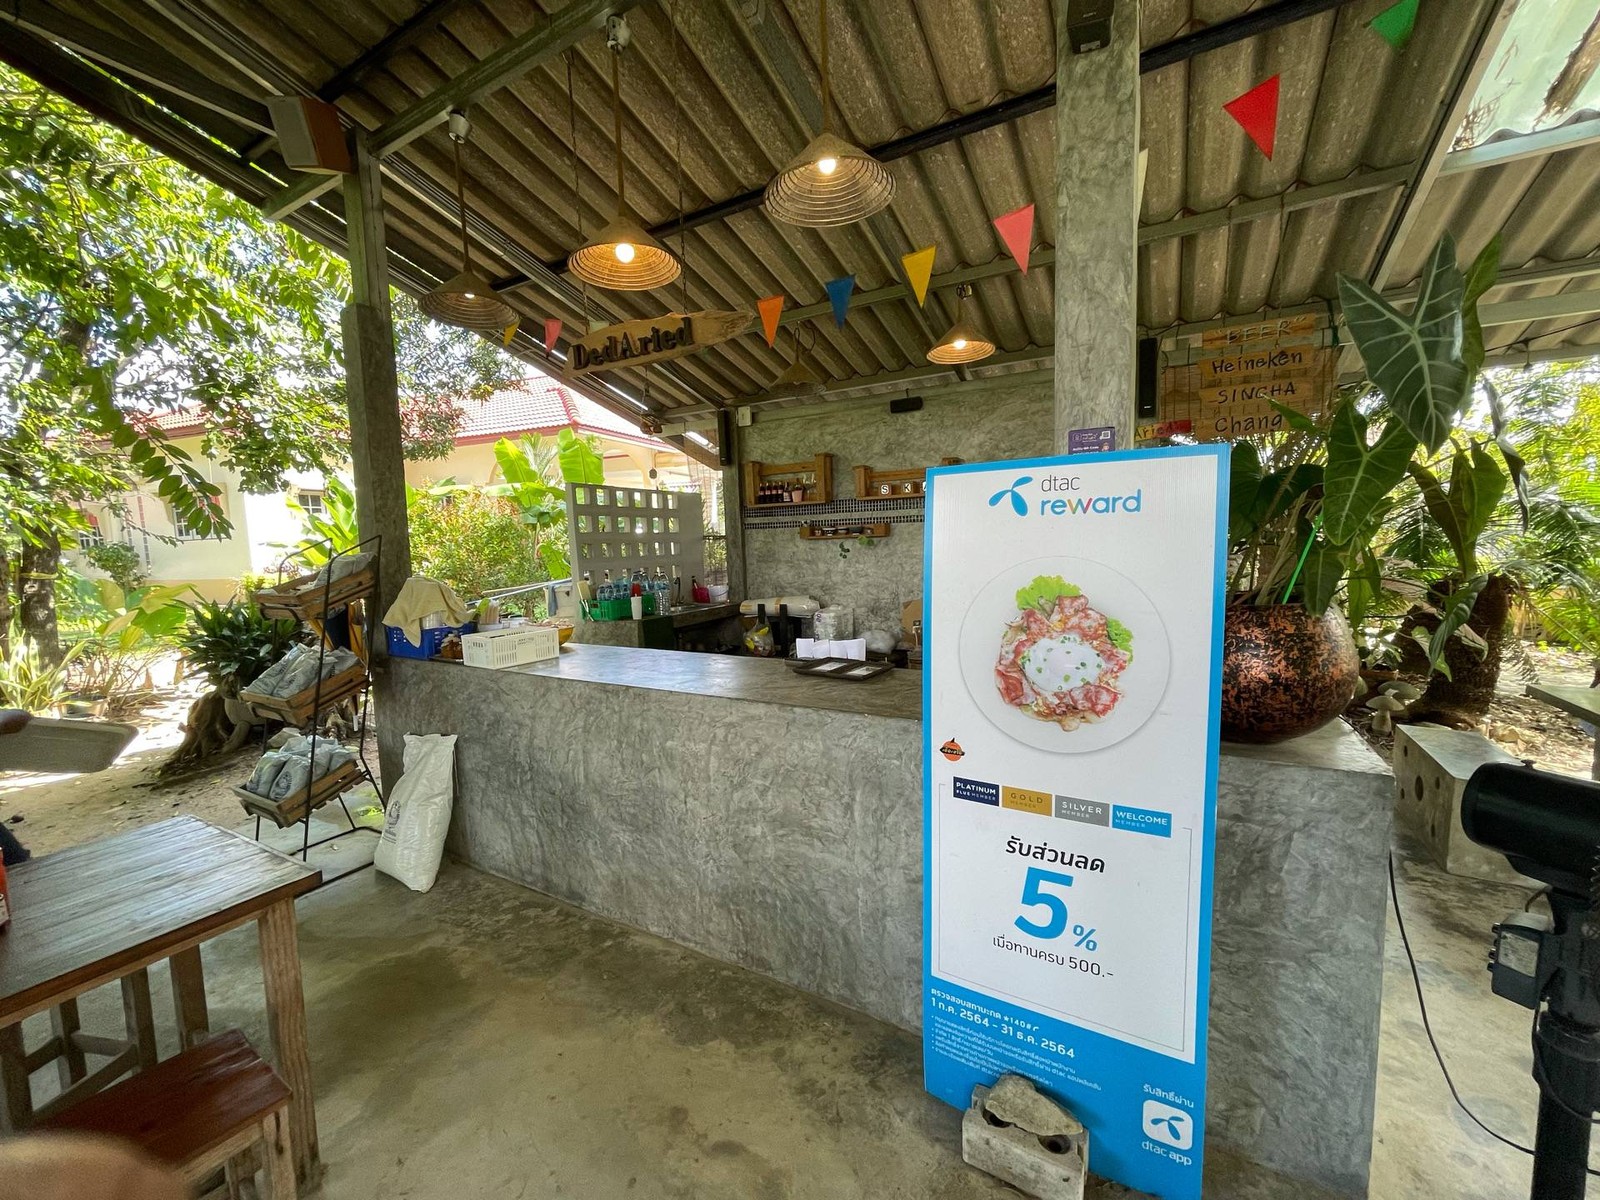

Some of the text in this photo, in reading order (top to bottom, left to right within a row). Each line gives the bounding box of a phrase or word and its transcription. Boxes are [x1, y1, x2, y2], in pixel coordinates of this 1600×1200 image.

[1212, 350, 1302, 374] Heineken
[1218, 381, 1296, 404] SINGHA
[1215, 414, 1283, 433] Chang
[1040, 474, 1081, 492] dtac
[1040, 488, 1142, 516] reward
[956, 781, 996, 795] PLATINUM
[971, 792, 996, 801] MEMBER
[1010, 792, 1043, 804] GOLD
[1061, 810, 1090, 818] MEMBER
[1062, 801, 1102, 815] SILVER
[1115, 819, 1146, 828] MEMBER
[1116, 810, 1168, 826] WELCOME
[1005, 835, 1105, 873] รับส่วนลด
[992, 934, 1114, 978] เมื่อทานครบ 500.-
[960, 1008, 990, 1028] 2564
[1001, 1023, 1013, 1037] 31
[1041, 1037, 1075, 1059] 2564
[1141, 1141, 1192, 1166] dtac app
